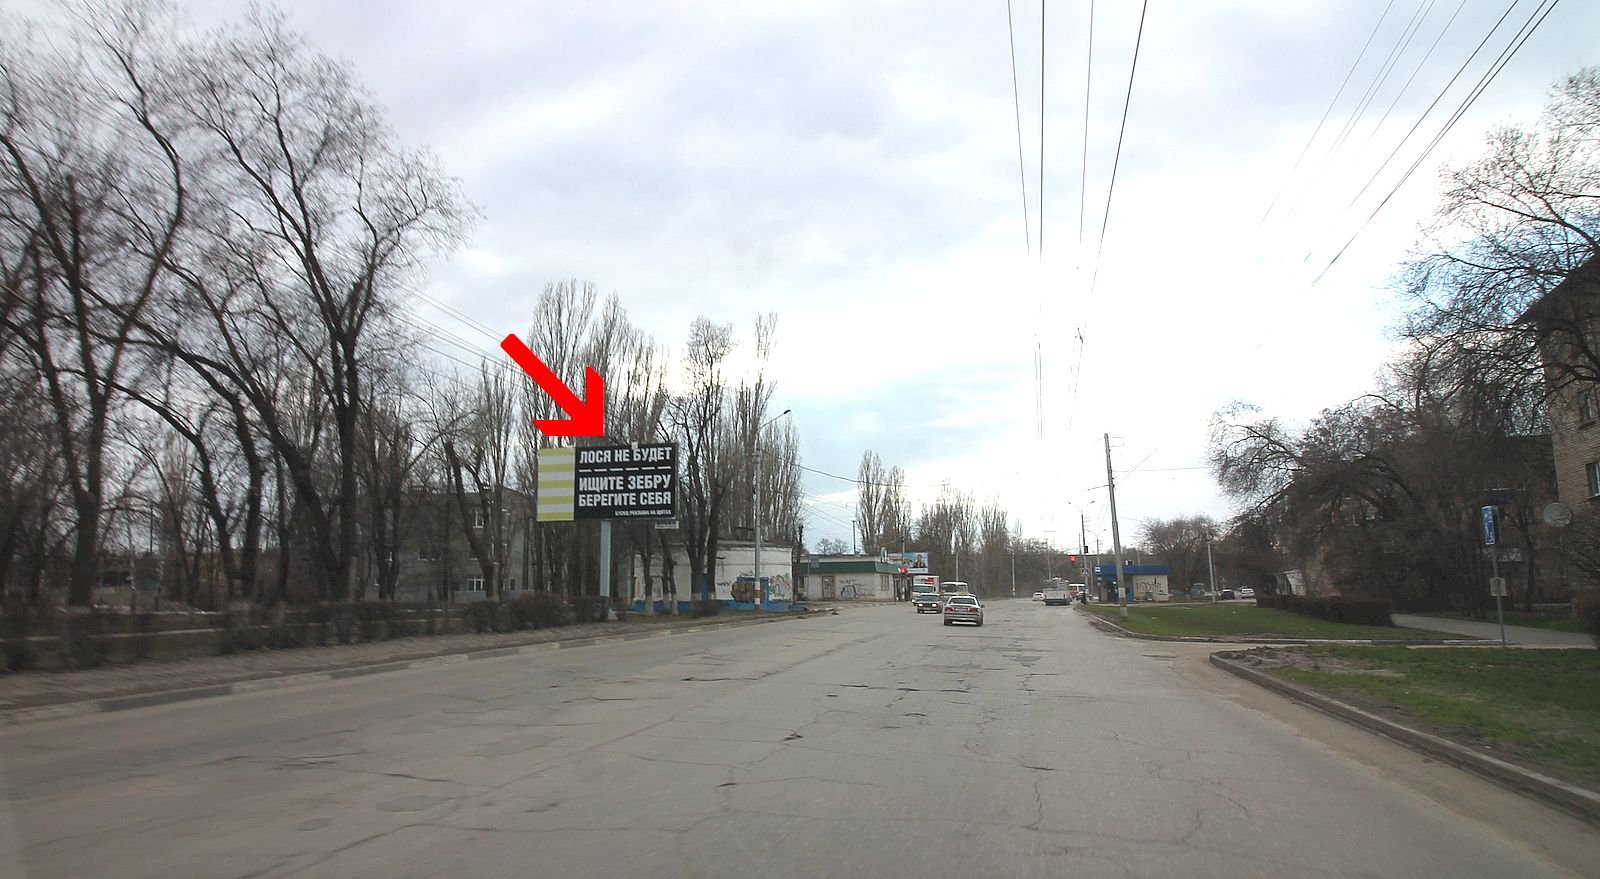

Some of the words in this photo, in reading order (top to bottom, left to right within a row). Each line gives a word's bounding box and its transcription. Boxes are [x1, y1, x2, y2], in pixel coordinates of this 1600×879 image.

[580, 450, 611, 463] ЛОСЯ
[615, 449, 630, 462] НЕ
[633, 447, 672, 462] БУДЕТ
[579, 476, 623, 492] ИЩИТЕ
[628, 474, 671, 489] ЗЕБРУ
[579, 493, 636, 506] БЕРЕГИТЕ
[640, 492, 671, 505] СЕБЯ
